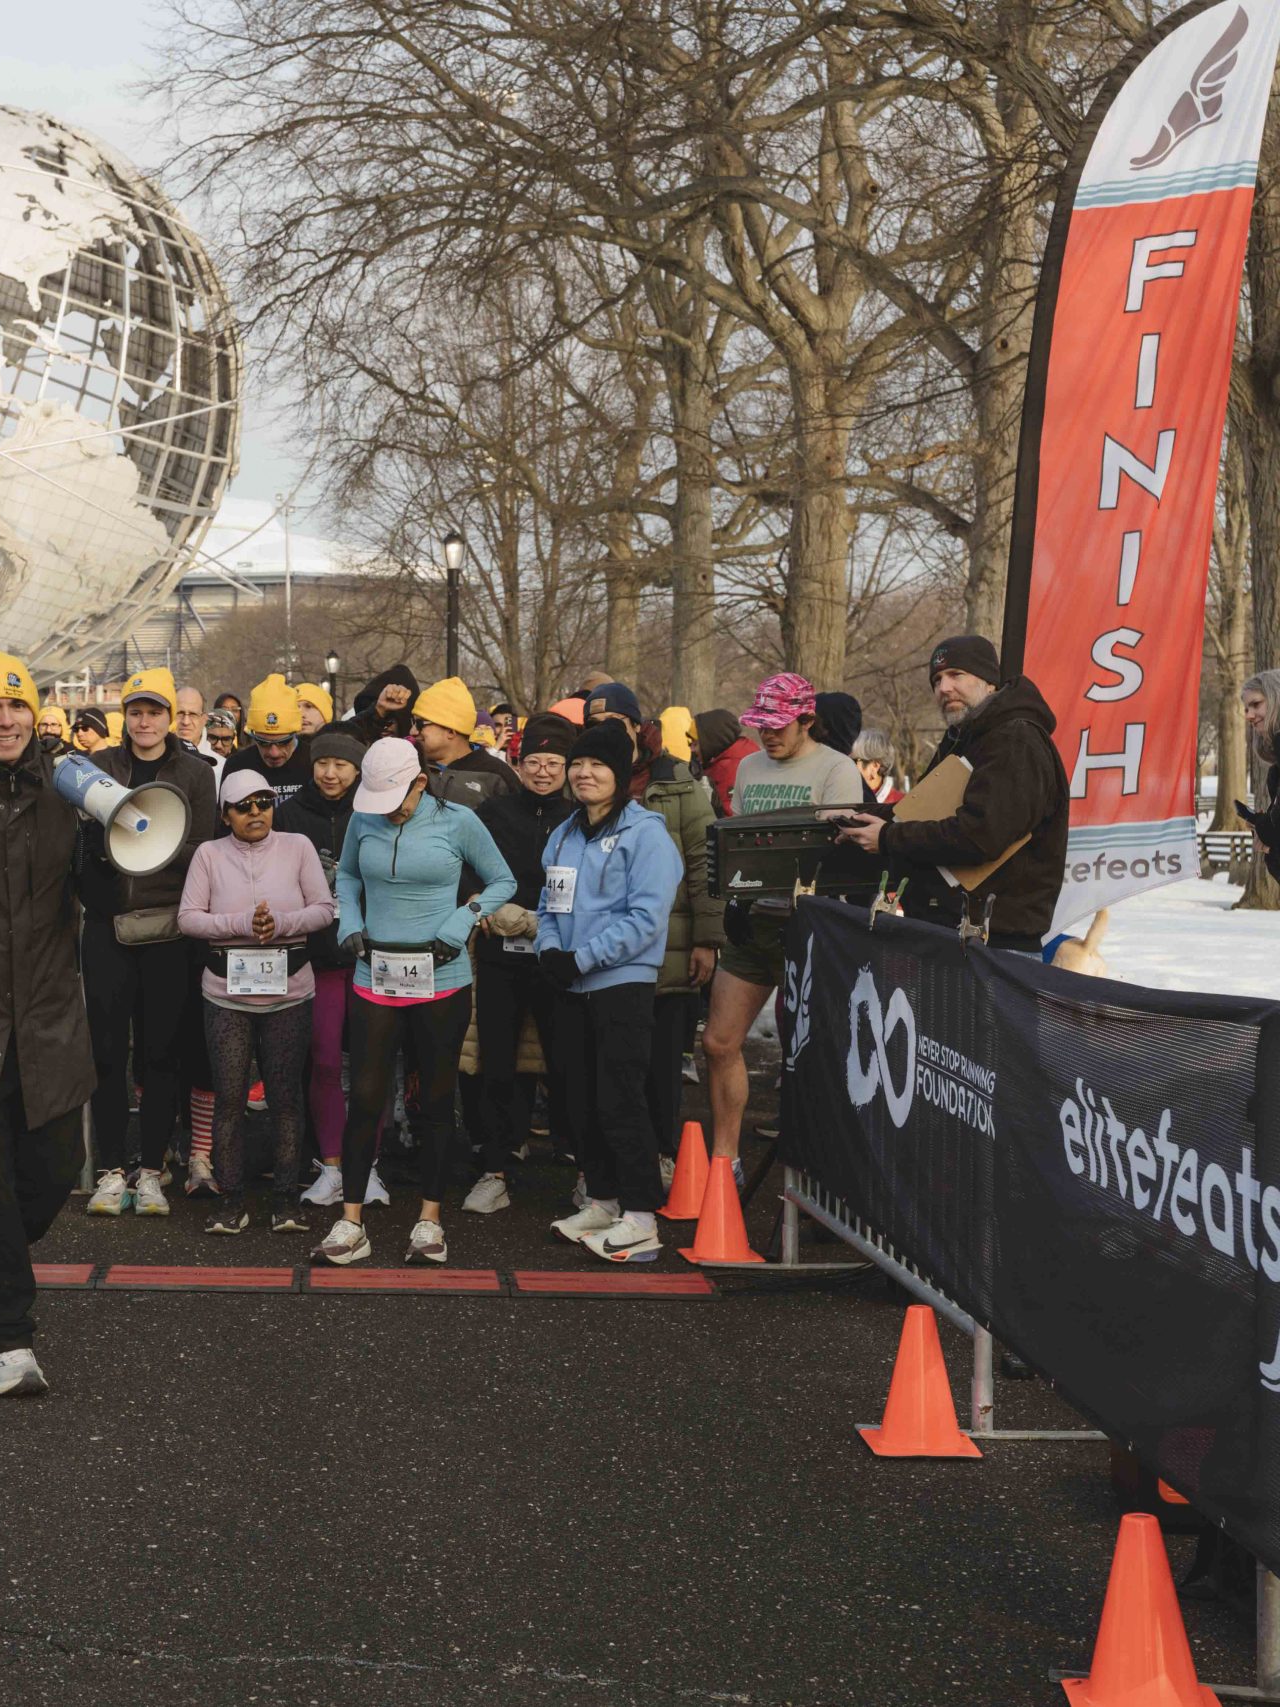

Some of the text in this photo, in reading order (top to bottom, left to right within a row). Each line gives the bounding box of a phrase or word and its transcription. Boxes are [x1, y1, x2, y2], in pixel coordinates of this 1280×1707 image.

[1069, 229, 1198, 799] FINISH
[743, 784, 812, 800] DEMOCRATIC
[547, 878, 565, 892] 414
[260, 961, 274, 974] 13
[403, 964, 418, 978] 14
[918, 1034, 997, 1094] NEVER STOP RUNNING
[916, 1064, 996, 1141] FOUNDATION
[1059, 1077, 1280, 1283] elitefeats
